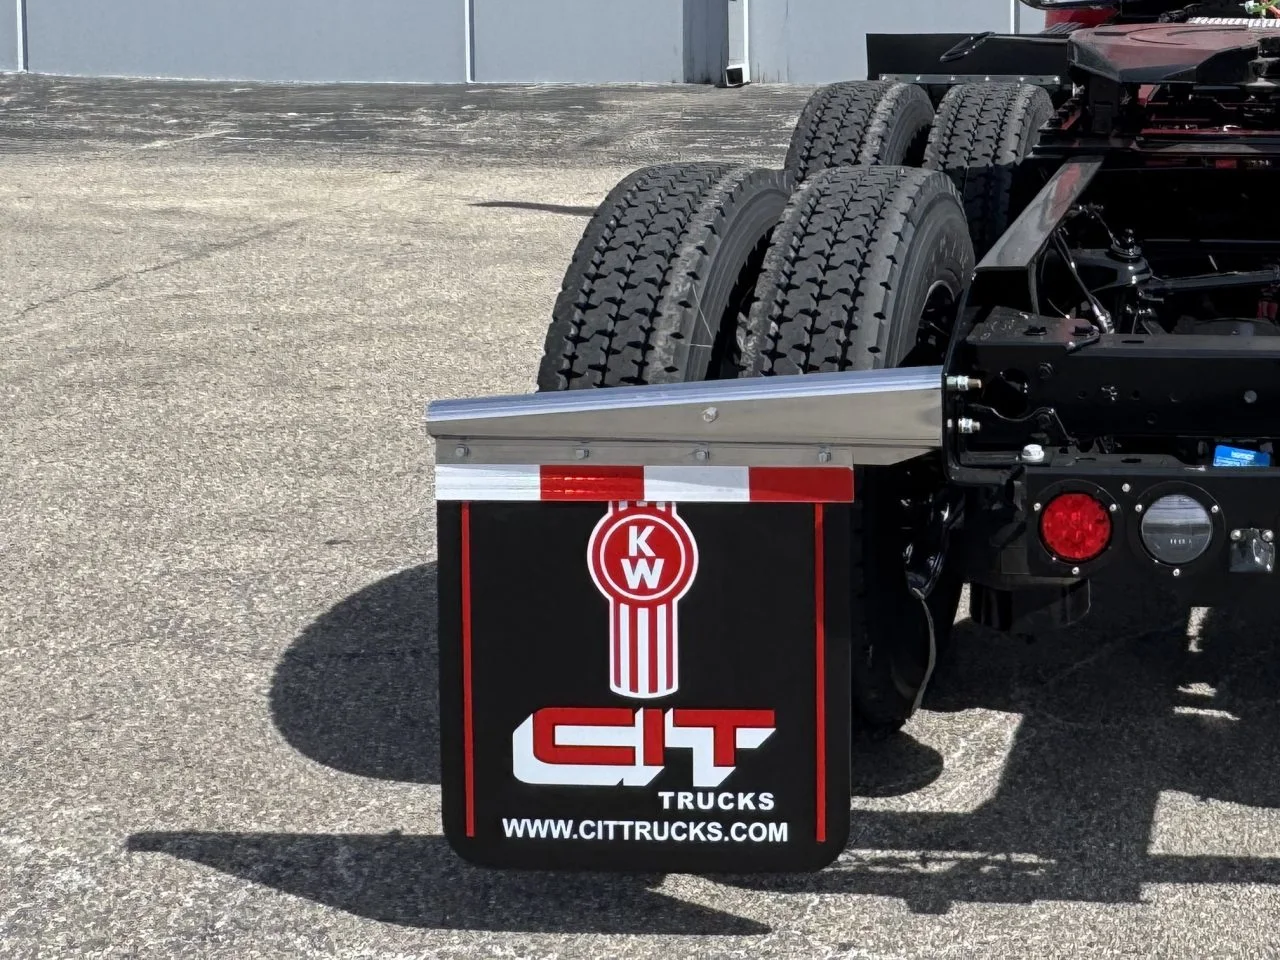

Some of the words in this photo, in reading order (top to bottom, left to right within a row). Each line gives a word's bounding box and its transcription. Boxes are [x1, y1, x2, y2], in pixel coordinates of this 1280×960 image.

[512, 707, 777, 787] CIT
[658, 791, 775, 811] TRUCKS
[502, 818, 789, 842] WWW.CITTRUCKS.COM
